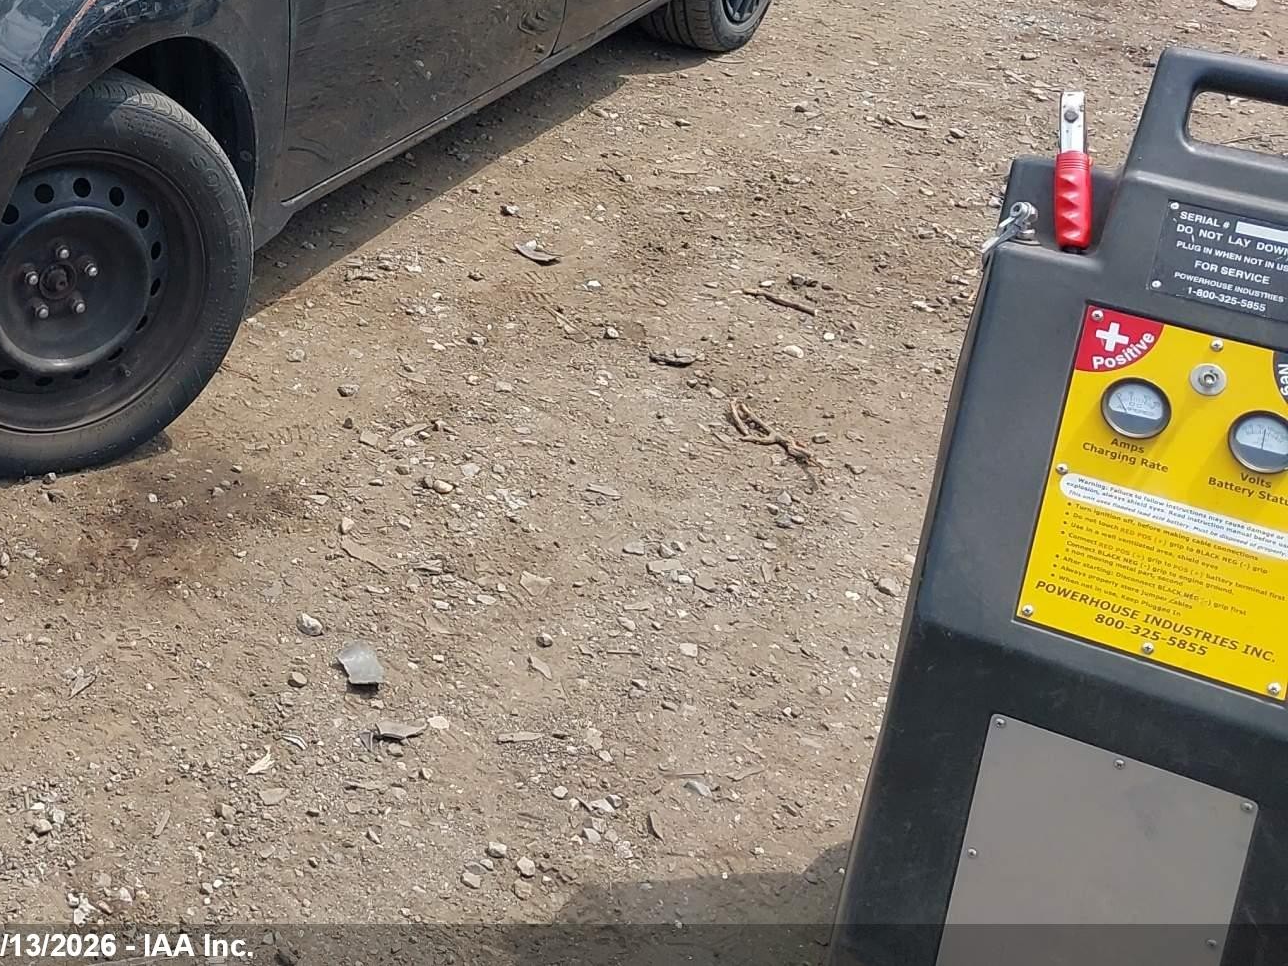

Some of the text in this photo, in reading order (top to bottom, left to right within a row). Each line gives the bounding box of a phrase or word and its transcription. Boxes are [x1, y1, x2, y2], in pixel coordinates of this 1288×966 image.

[1180, 211, 1220, 227] SERIAL
[1176, 224, 1193, 234] DO
[1199, 228, 1223, 241] NOT
[1228, 236, 1252, 248] LAY
[1176, 240, 1202, 252] PLUG
[1214, 248, 1242, 262] WHEN
[1244, 256, 1264, 266] NOT
[1265, 260, 1274, 268] IN
[1194, 260, 1271, 285] FOR SERVICE
[1174, 272, 1284, 303] POWERHOUSE INDUSTRIES
[1188, 286, 1266, 312] 1-800-325-5855
[1092, 331, 1155, 370] Positive
[1082, 442, 1169, 473] Charging Rate
[1110, 438, 1144, 455] Amps
[1208, 476, 1255, 497] Battery
[1240, 472, 1272, 488] Volts
[1143, 496, 1164, 506] follow
[1166, 502, 1206, 518] instructions
[1208, 515, 1222, 523] may
[1093, 509, 1120, 521] ignition
[1137, 522, 1160, 532] before
[1162, 529, 1189, 541] making
[1192, 538, 1211, 546] cable
[1213, 544, 1258, 561] connections
[1098, 520, 1118, 530] touch
[1120, 527, 1134, 535] RED
[1137, 532, 1152, 540] POS
[1169, 541, 1184, 550] grip
[1195, 549, 1219, 559] BLACK
[1222, 557, 1237, 565] NEG
[1252, 566, 1268, 574] grip
[1066, 540, 1095, 553] Connect
[1097, 550, 1121, 560] BLACK
[1152, 566, 1167, 575] grip
[1068, 532, 1097, 545] Connect
[1205, 574, 1232, 586] battery
[1235, 581, 1268, 597] terminal
[1269, 592, 1286, 602] first
[1177, 554, 1199, 564] shield
[1201, 561, 1218, 570] eyes
[1060, 565, 1086, 576] Always
[1087, 573, 1118, 587] properly
[1063, 556, 1080, 565] After
[1157, 585, 1181, 596] BLACK
[1035, 580, 1276, 663] POWERHOUSE INDUSTRIES INC.
[1094, 613, 1208, 656] 800-325-5855
